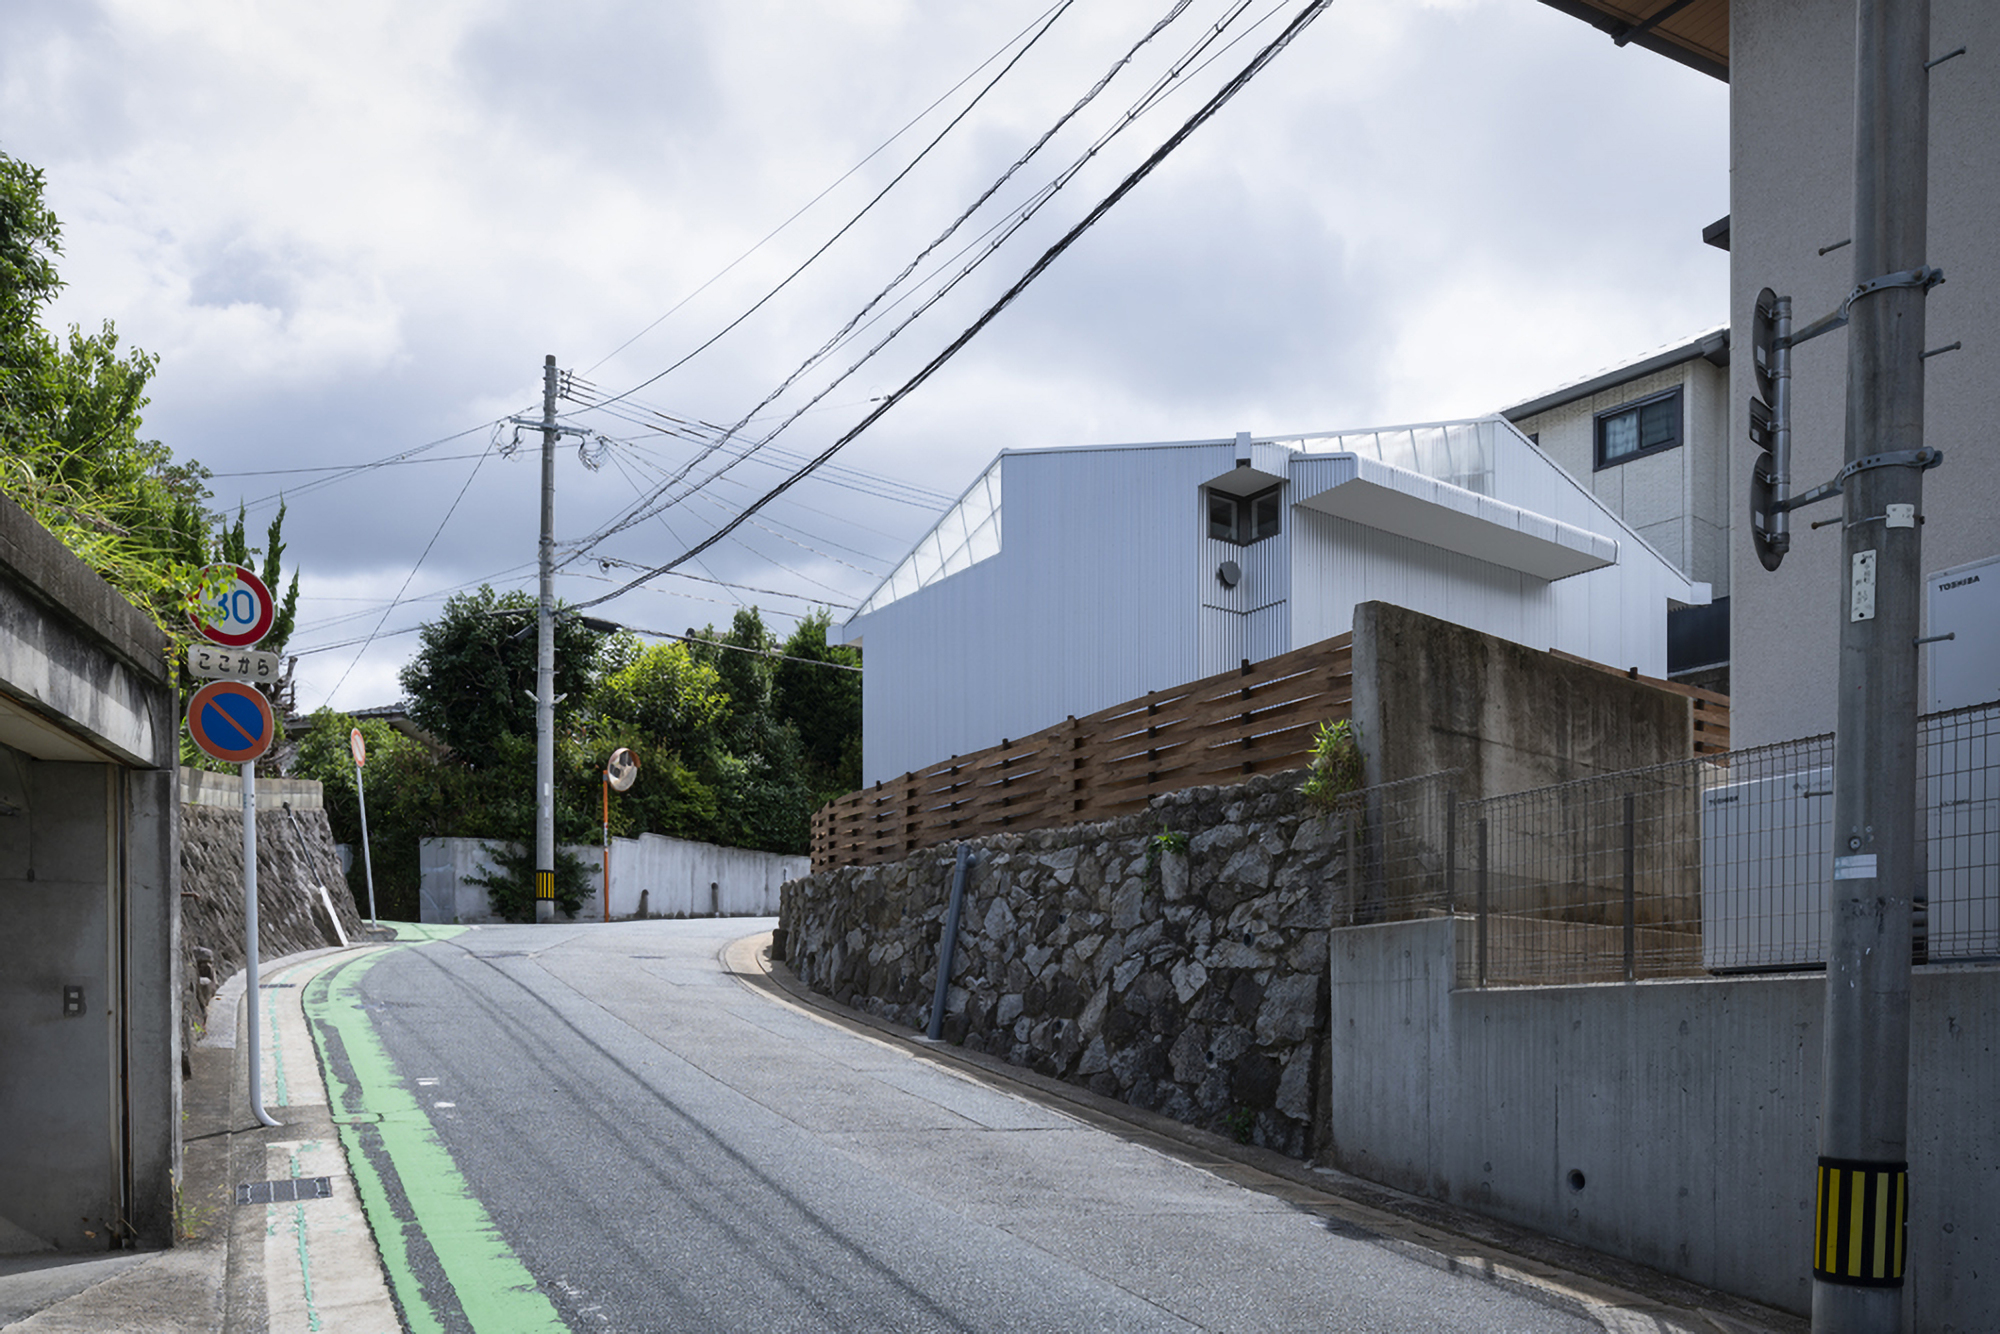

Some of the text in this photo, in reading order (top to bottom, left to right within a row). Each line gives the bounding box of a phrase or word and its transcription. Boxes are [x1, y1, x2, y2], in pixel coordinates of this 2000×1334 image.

[1938, 575, 1980, 592] TOSHIBA
[198, 652, 270, 677] ここから
